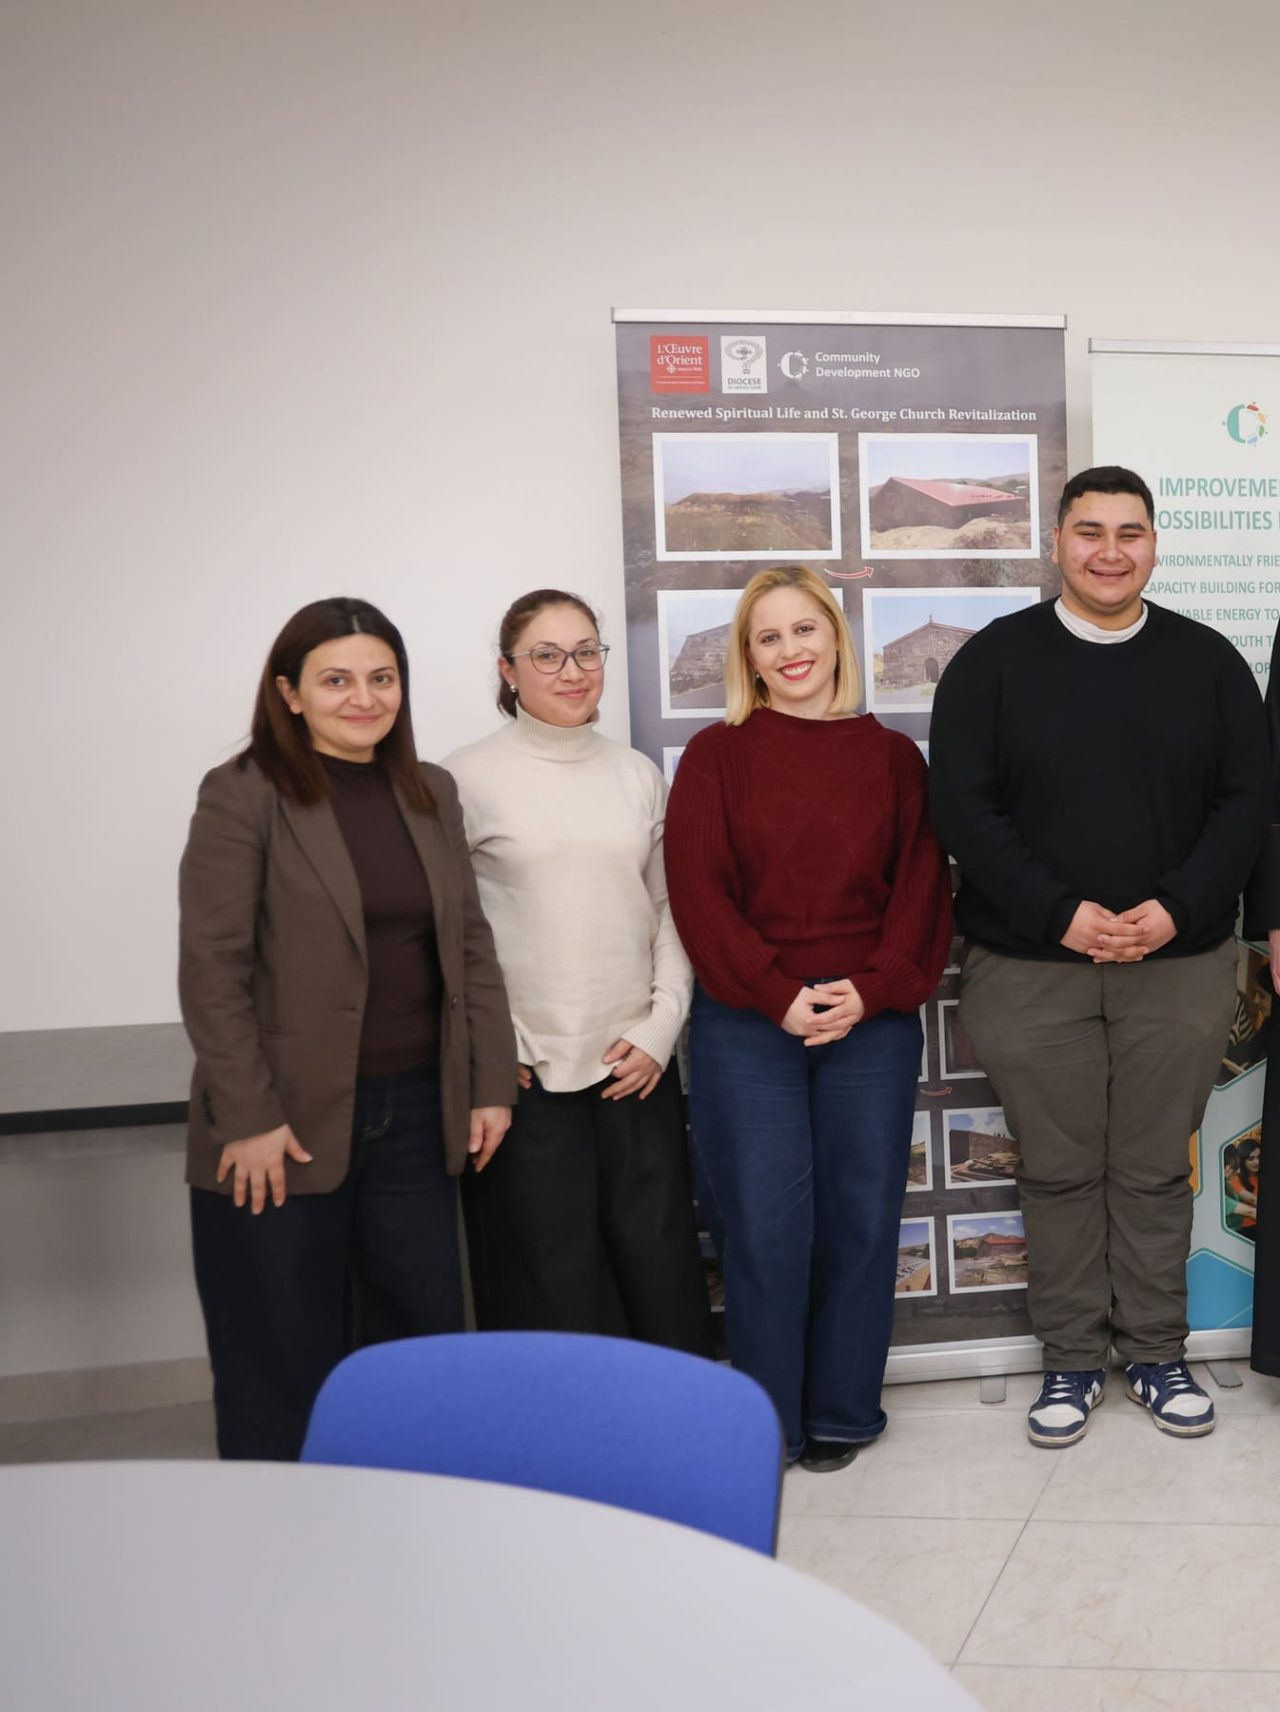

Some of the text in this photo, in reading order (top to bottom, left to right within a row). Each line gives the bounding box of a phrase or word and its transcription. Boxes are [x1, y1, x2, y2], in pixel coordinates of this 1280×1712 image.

[656, 354, 703, 365] d'Orient
[815, 352, 880, 364] Community
[816, 367, 920, 379] Development NGO
[727, 378, 761, 386] DIOCESE
[651, 407, 1037, 422] Renewed Spiritual Life and St. George Church Revitalization
[1154, 510, 1271, 530] OSSIBILITIES
[1157, 554, 1254, 567] VIRONMENTALLY
[1201, 581, 1256, 594] BUILDING
[1216, 608, 1260, 621] ENERGY
